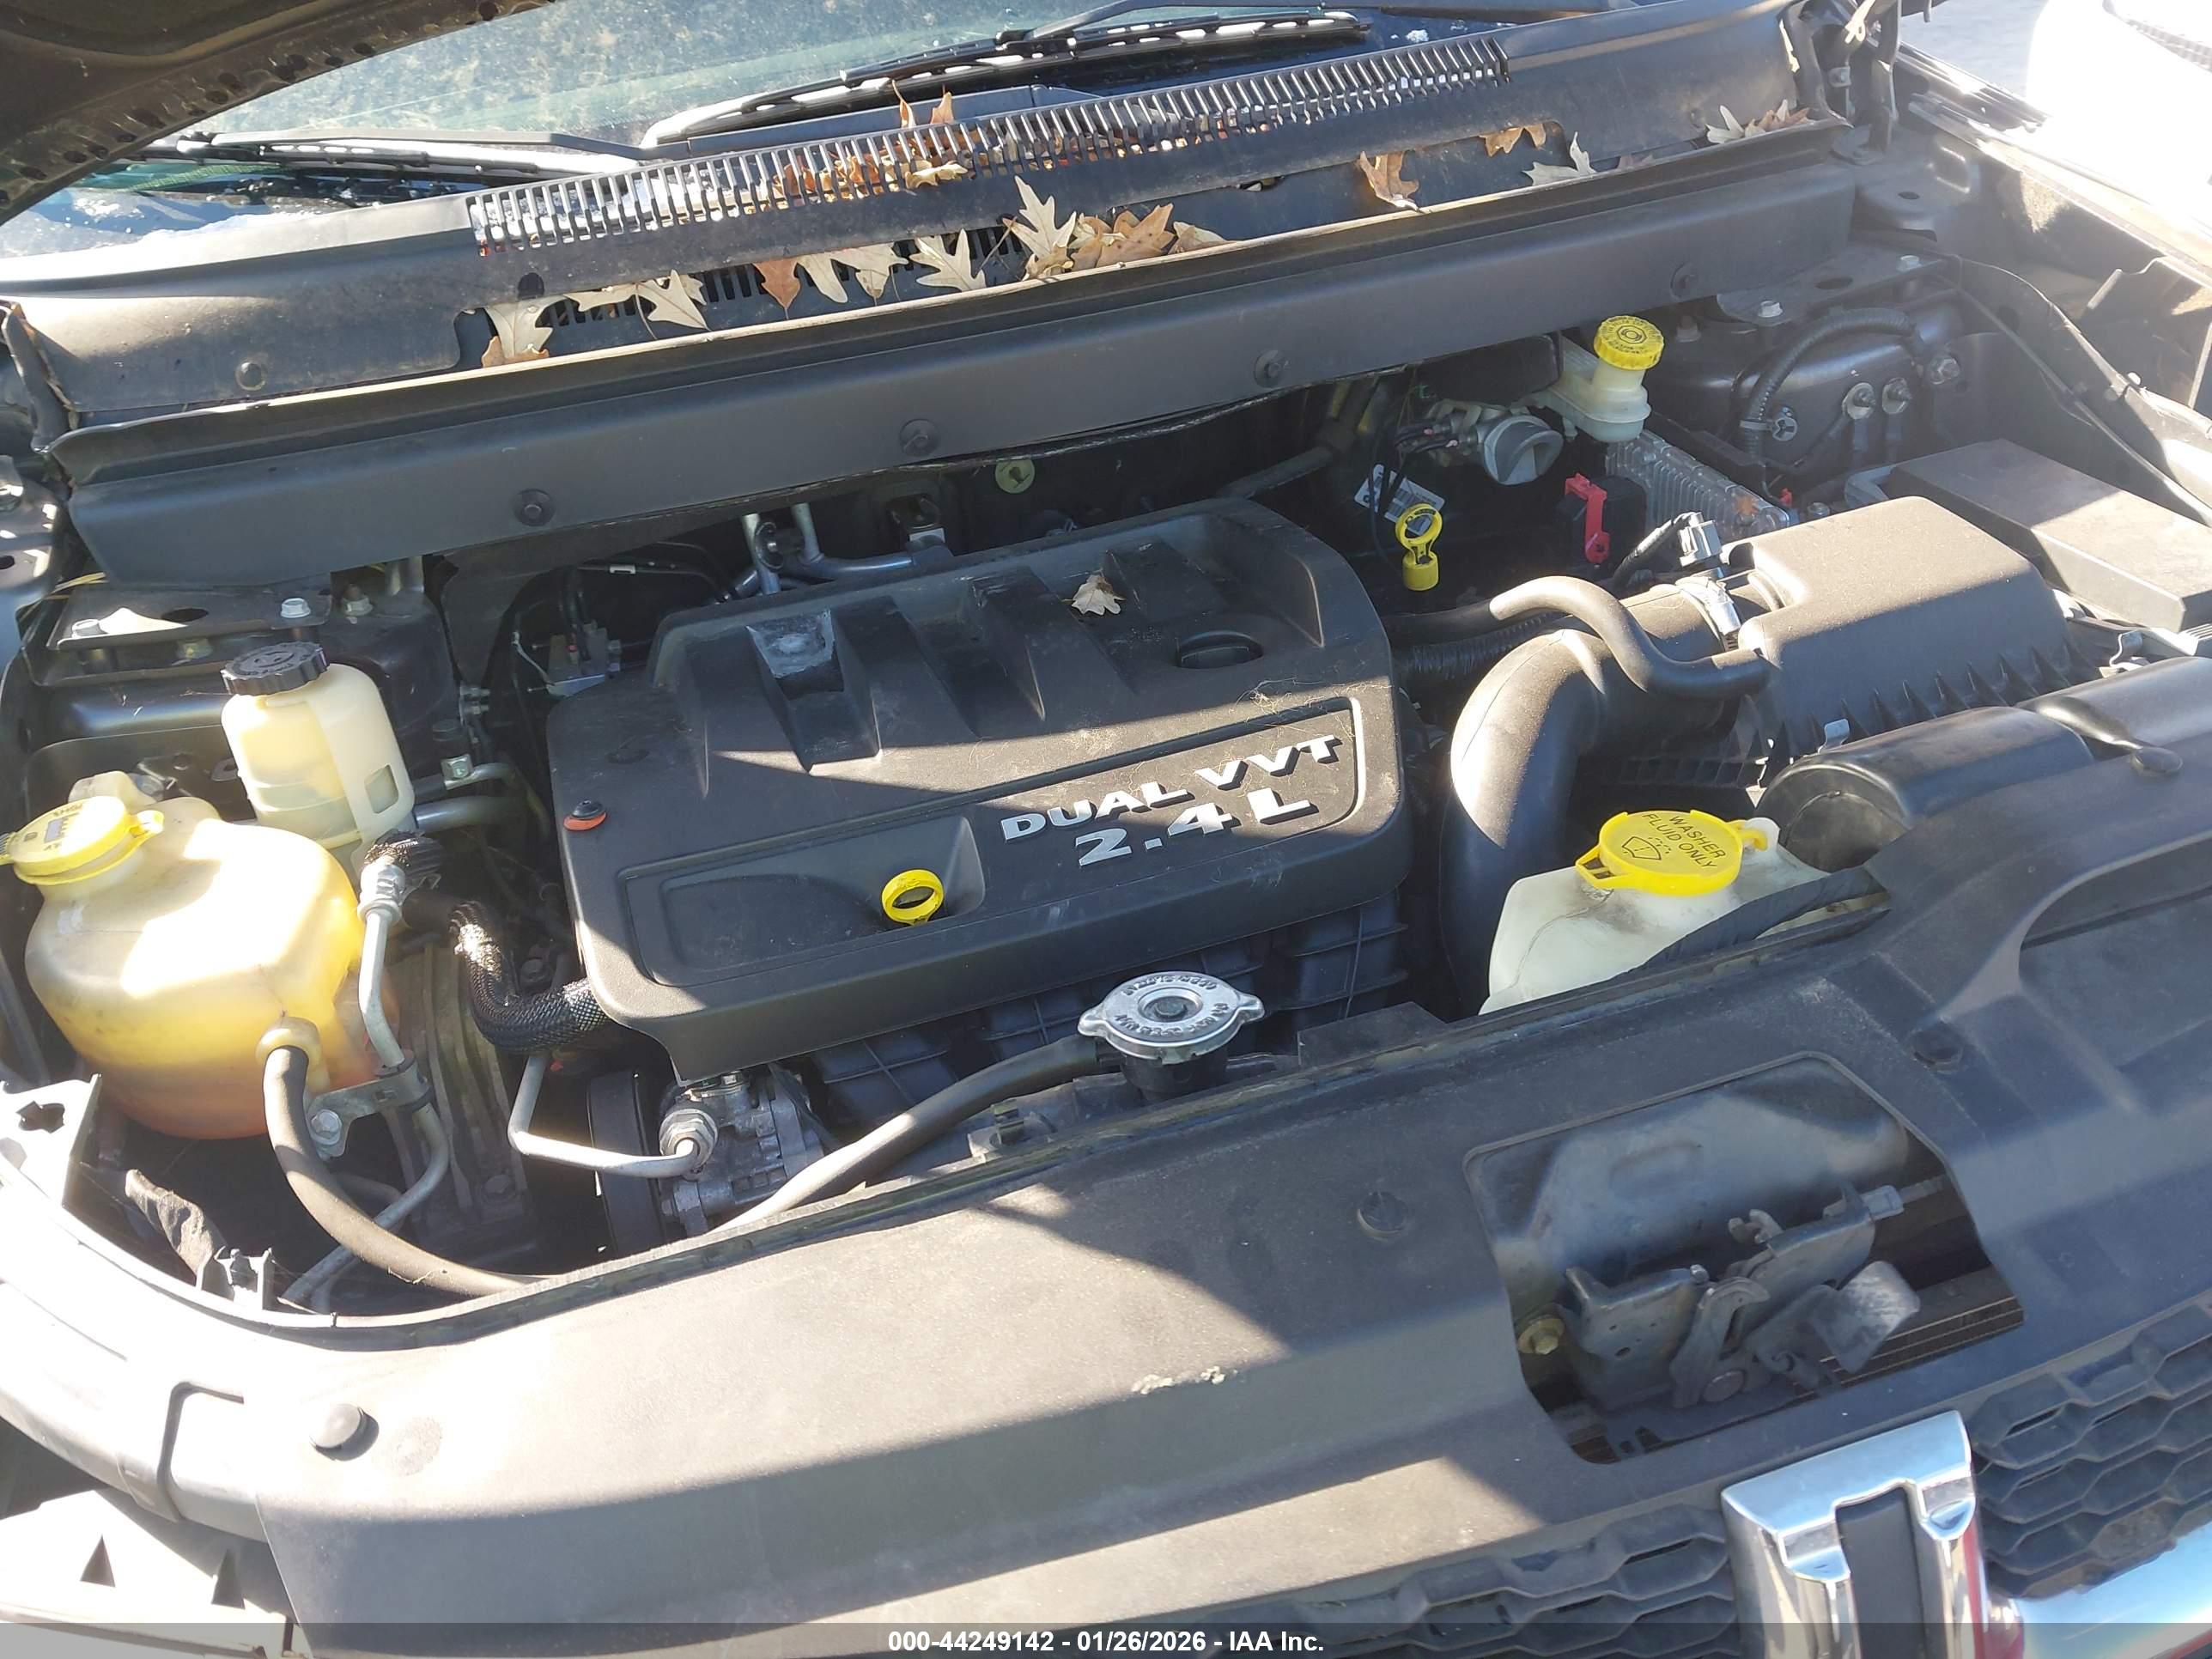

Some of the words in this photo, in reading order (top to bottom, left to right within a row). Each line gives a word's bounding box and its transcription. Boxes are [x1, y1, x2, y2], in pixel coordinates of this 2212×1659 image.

[1000, 781, 1193, 843] DUAL
[1194, 734, 1340, 792] VVT
[1642, 812, 1681, 842] FLUID
[1678, 843, 1717, 869] ONLY
[1668, 815, 1726, 859] WASHER
